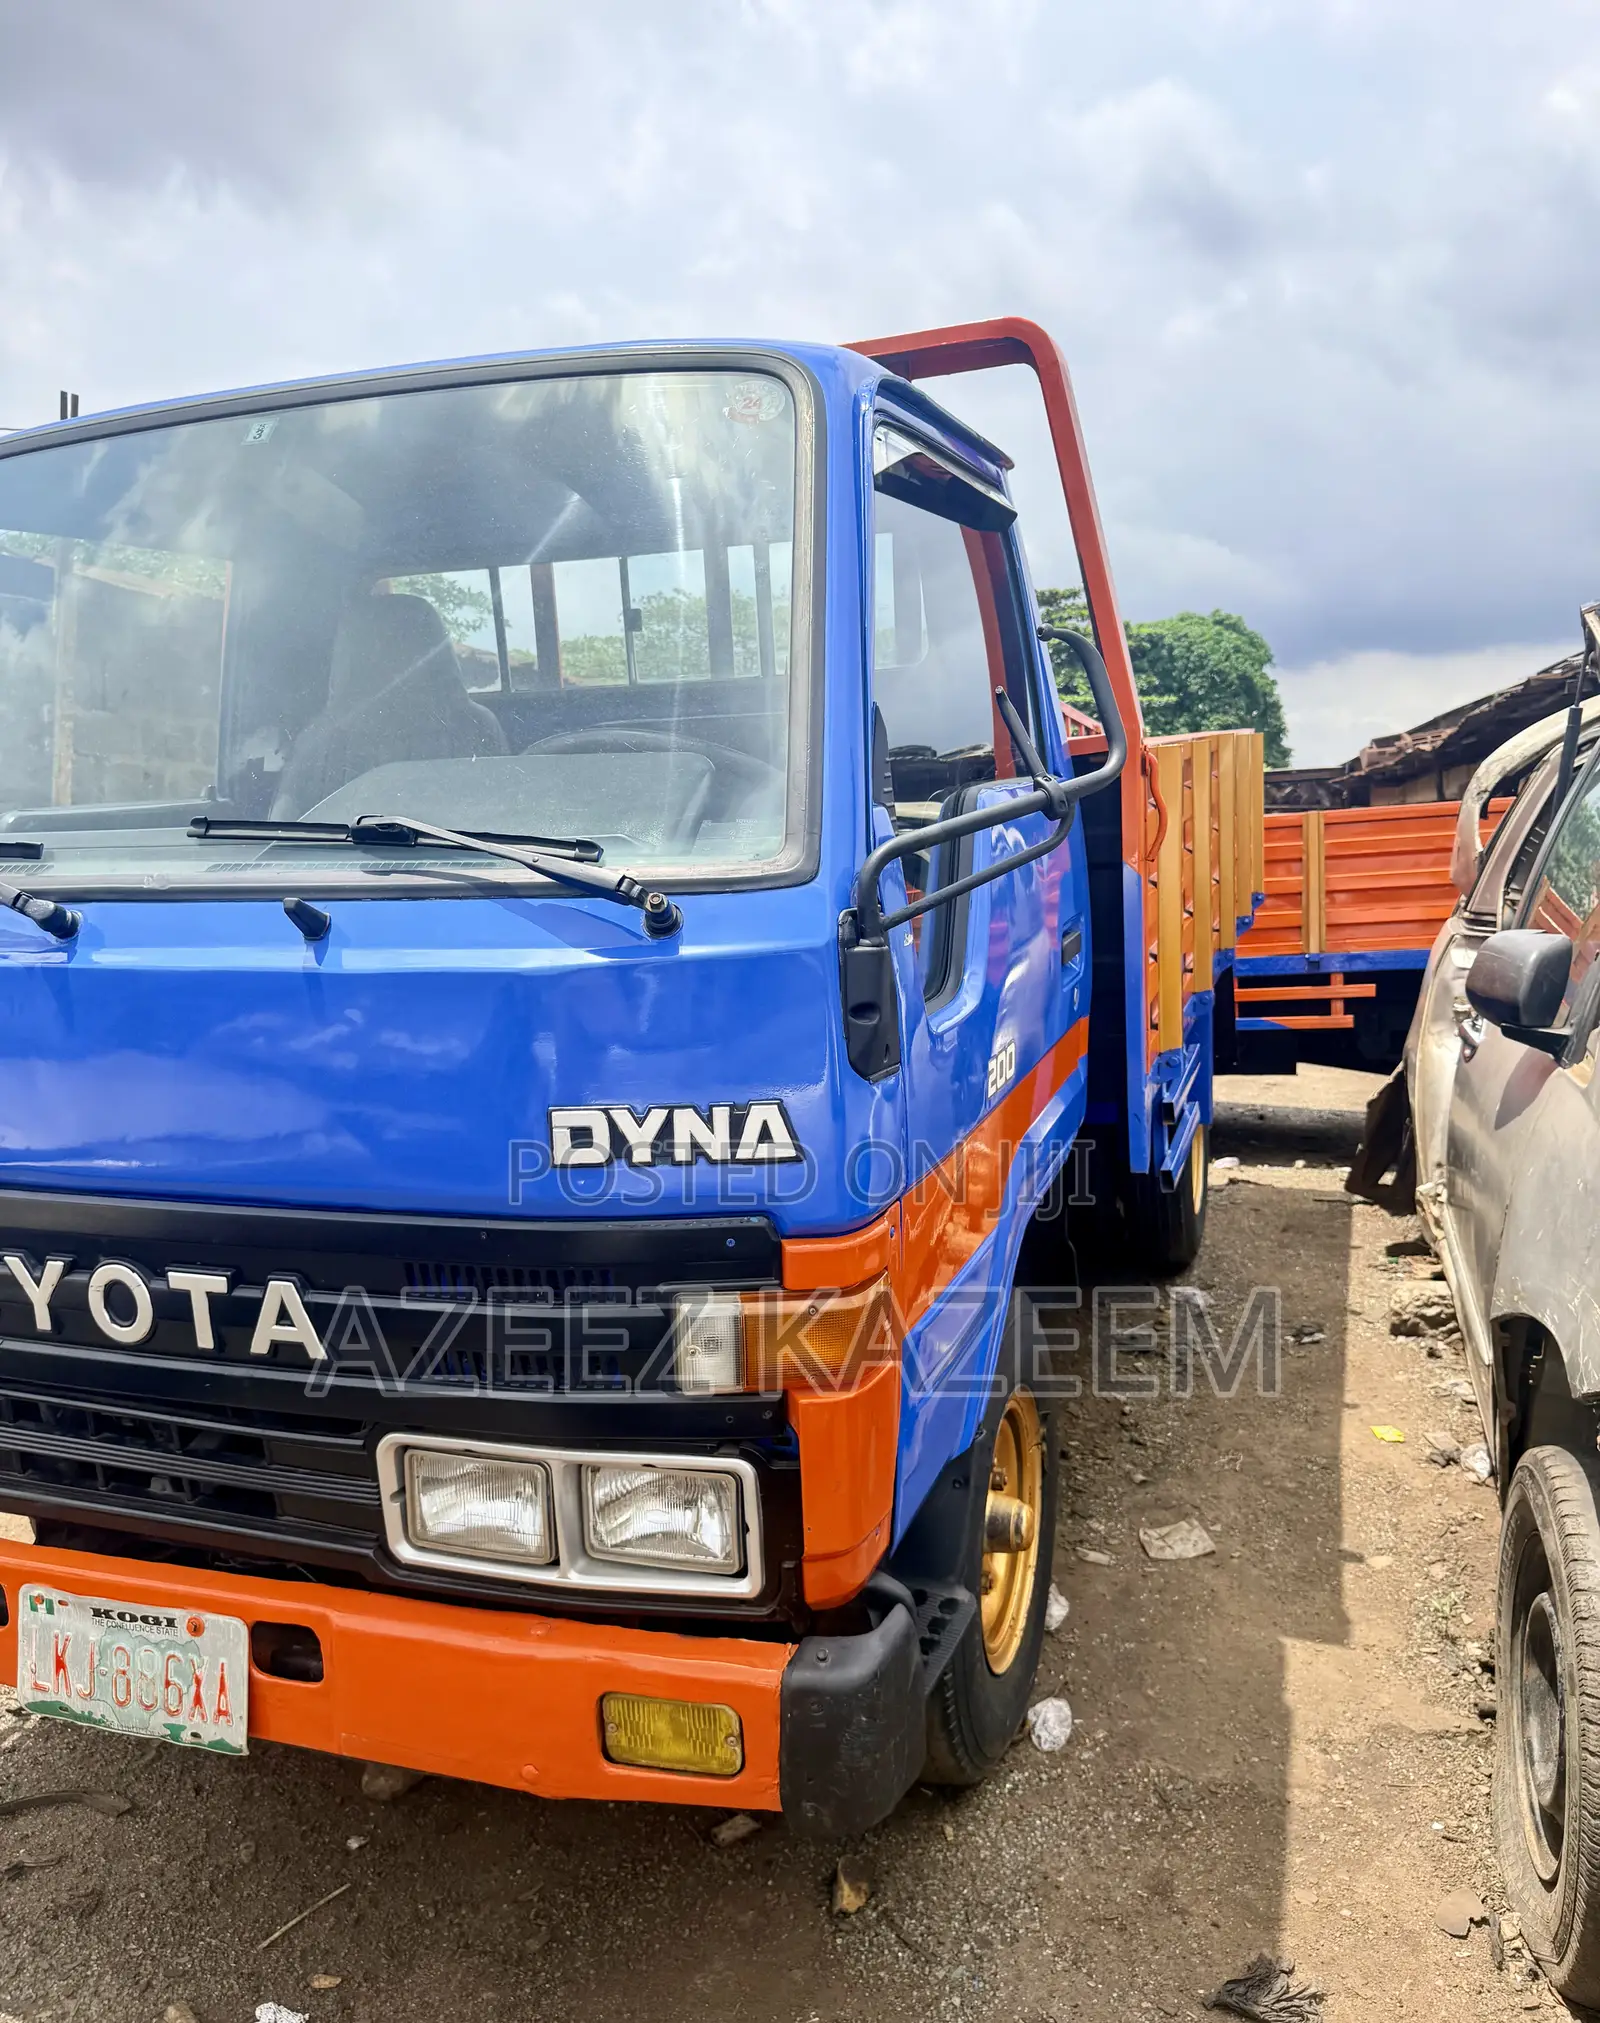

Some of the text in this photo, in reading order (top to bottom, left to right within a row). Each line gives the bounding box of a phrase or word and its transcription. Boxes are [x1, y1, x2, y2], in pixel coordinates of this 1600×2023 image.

[987, 1041, 1015, 1099] 200
[551, 1100, 803, 1166] DYNA
[3, 1255, 328, 1360] YOTA
[89, 1607, 179, 1629] KOGI
[91, 1618, 179, 1638] THE CONFLUENCE STATE
